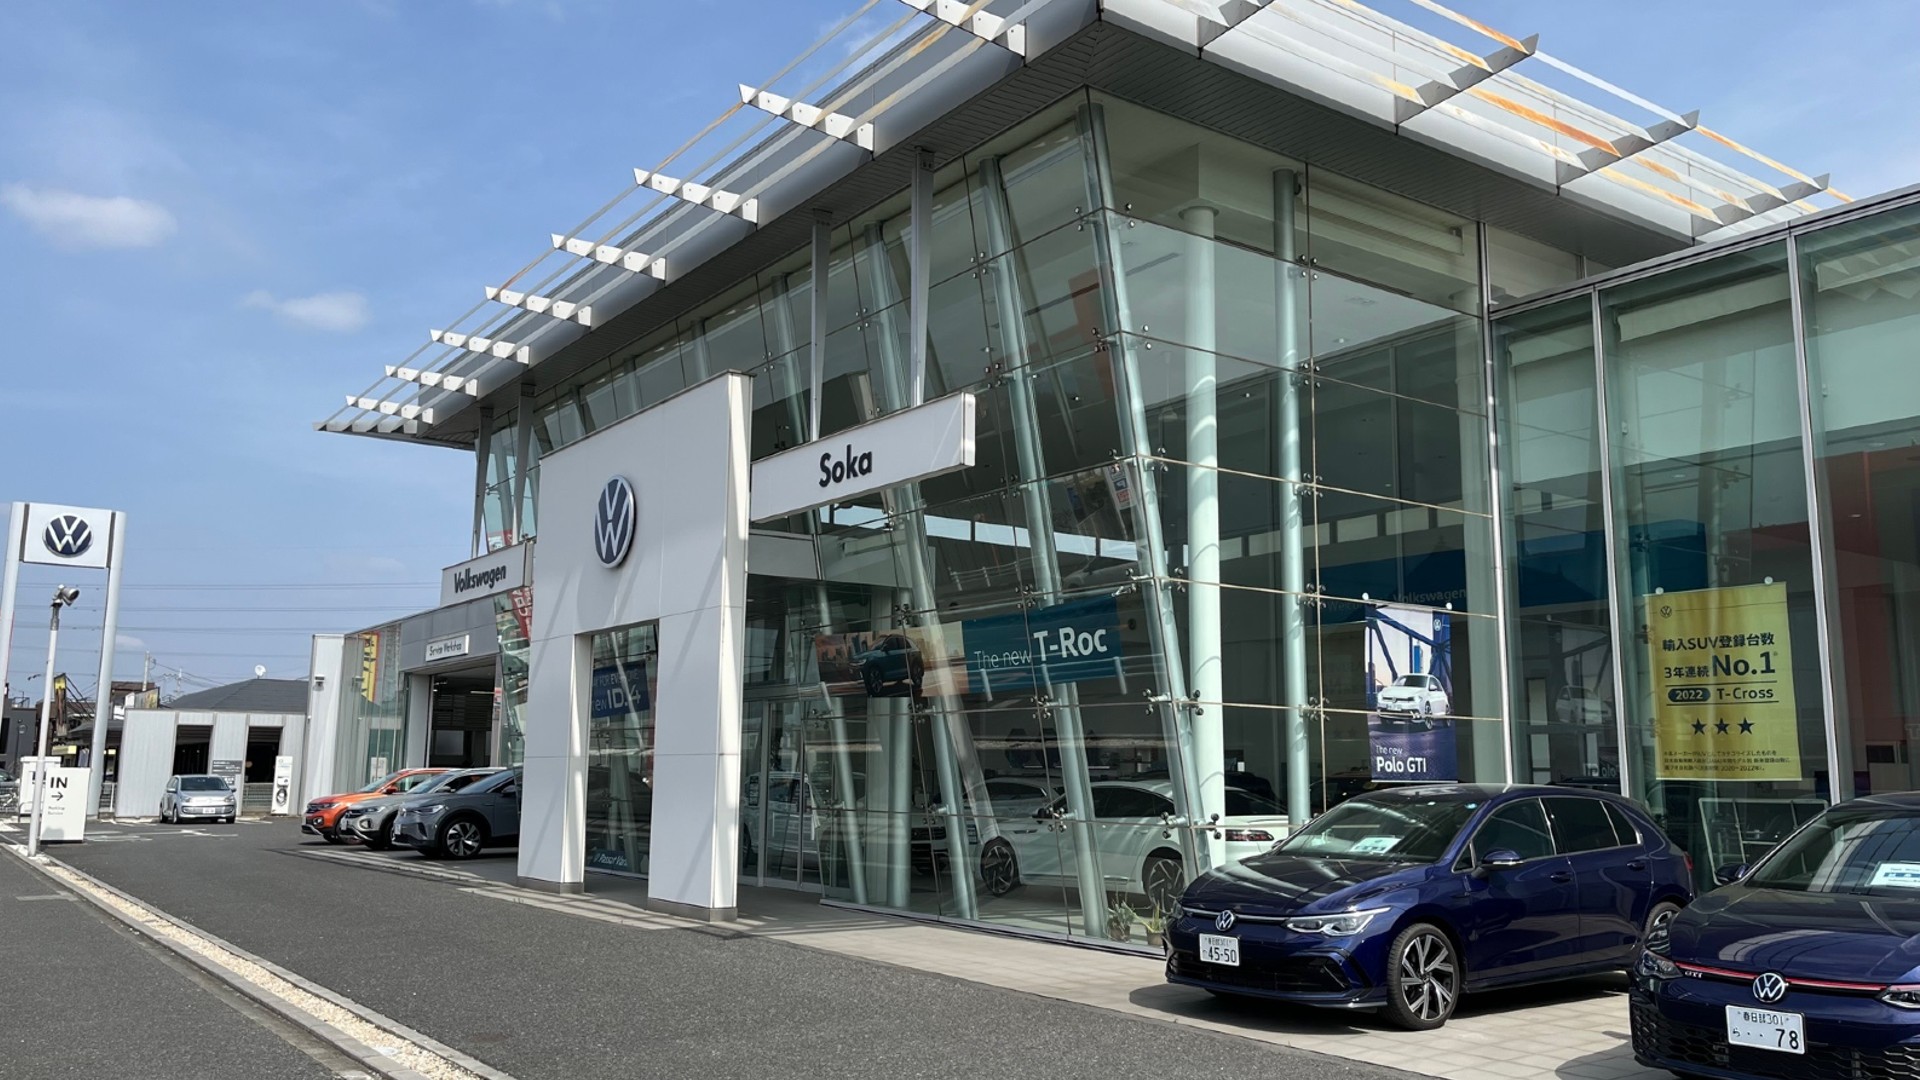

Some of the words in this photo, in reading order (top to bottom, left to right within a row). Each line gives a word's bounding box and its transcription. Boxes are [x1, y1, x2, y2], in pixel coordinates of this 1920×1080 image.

[818, 444, 873, 488] Soka
[454, 565, 506, 593] Volkswagen
[973, 650, 999, 669] The
[1003, 650, 1032, 667] new
[1033, 627, 1108, 662] T-Roc
[1662, 632, 1775, 651] 輸入SUV登録台数
[1664, 666, 1710, 678] 3年連続
[1711, 652, 1776, 677] No.1
[606, 684, 641, 709] ID.4
[1675, 690, 1703, 700] 2022
[1716, 687, 1774, 700] T-Cross
[1376, 745, 1388, 754] The
[1389, 746, 1403, 755] new
[1376, 756, 1404, 773] Polo
[1406, 757, 1428, 773] GTI
[50, 777, 68, 788] IN
[1208, 946, 1237, 963] 45-50
